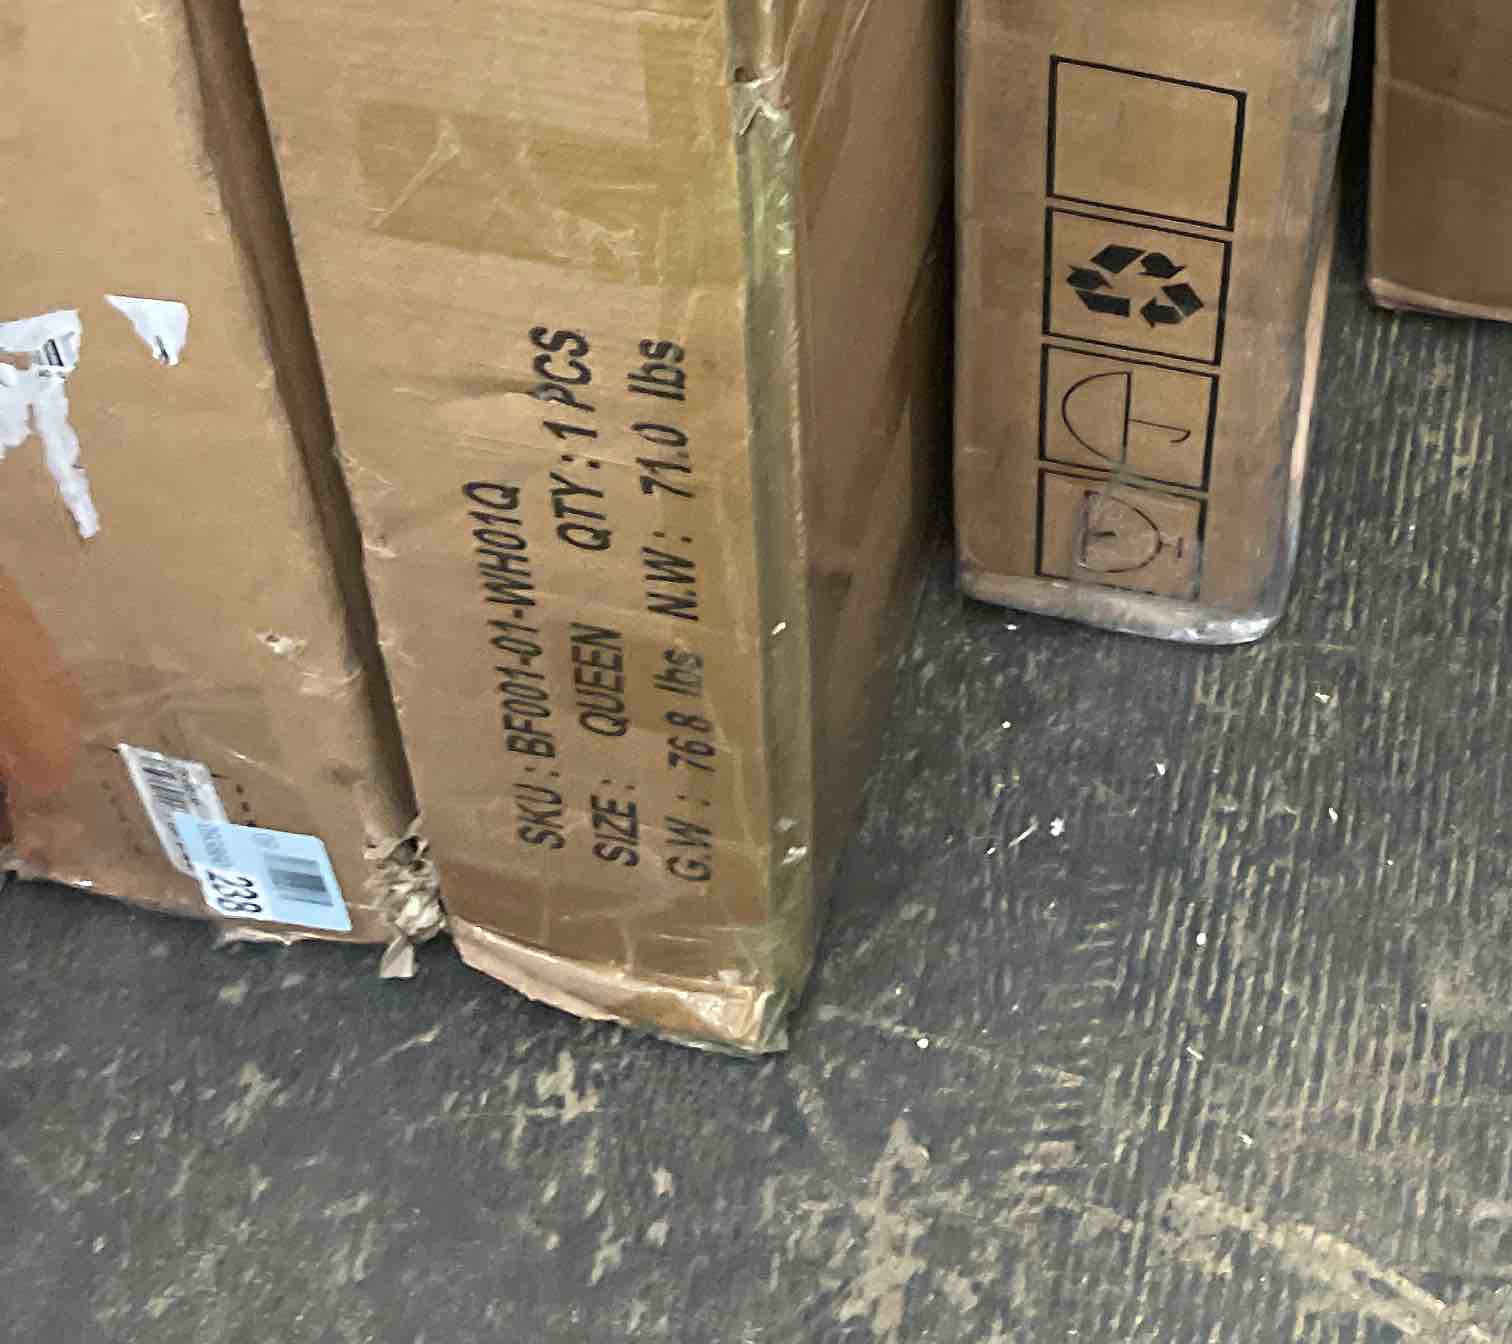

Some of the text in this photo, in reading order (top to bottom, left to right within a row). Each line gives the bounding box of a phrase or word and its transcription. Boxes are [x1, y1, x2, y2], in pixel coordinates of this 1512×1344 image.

[529, 326, 596, 412] PCS
[626, 338, 687, 402] lbs
[542, 420, 598, 440] 1
[630, 423, 696, 499] 71.0
[462, 481, 556, 759] BF001-01-WH01Q
[570, 622, 631, 737] QUEEN
